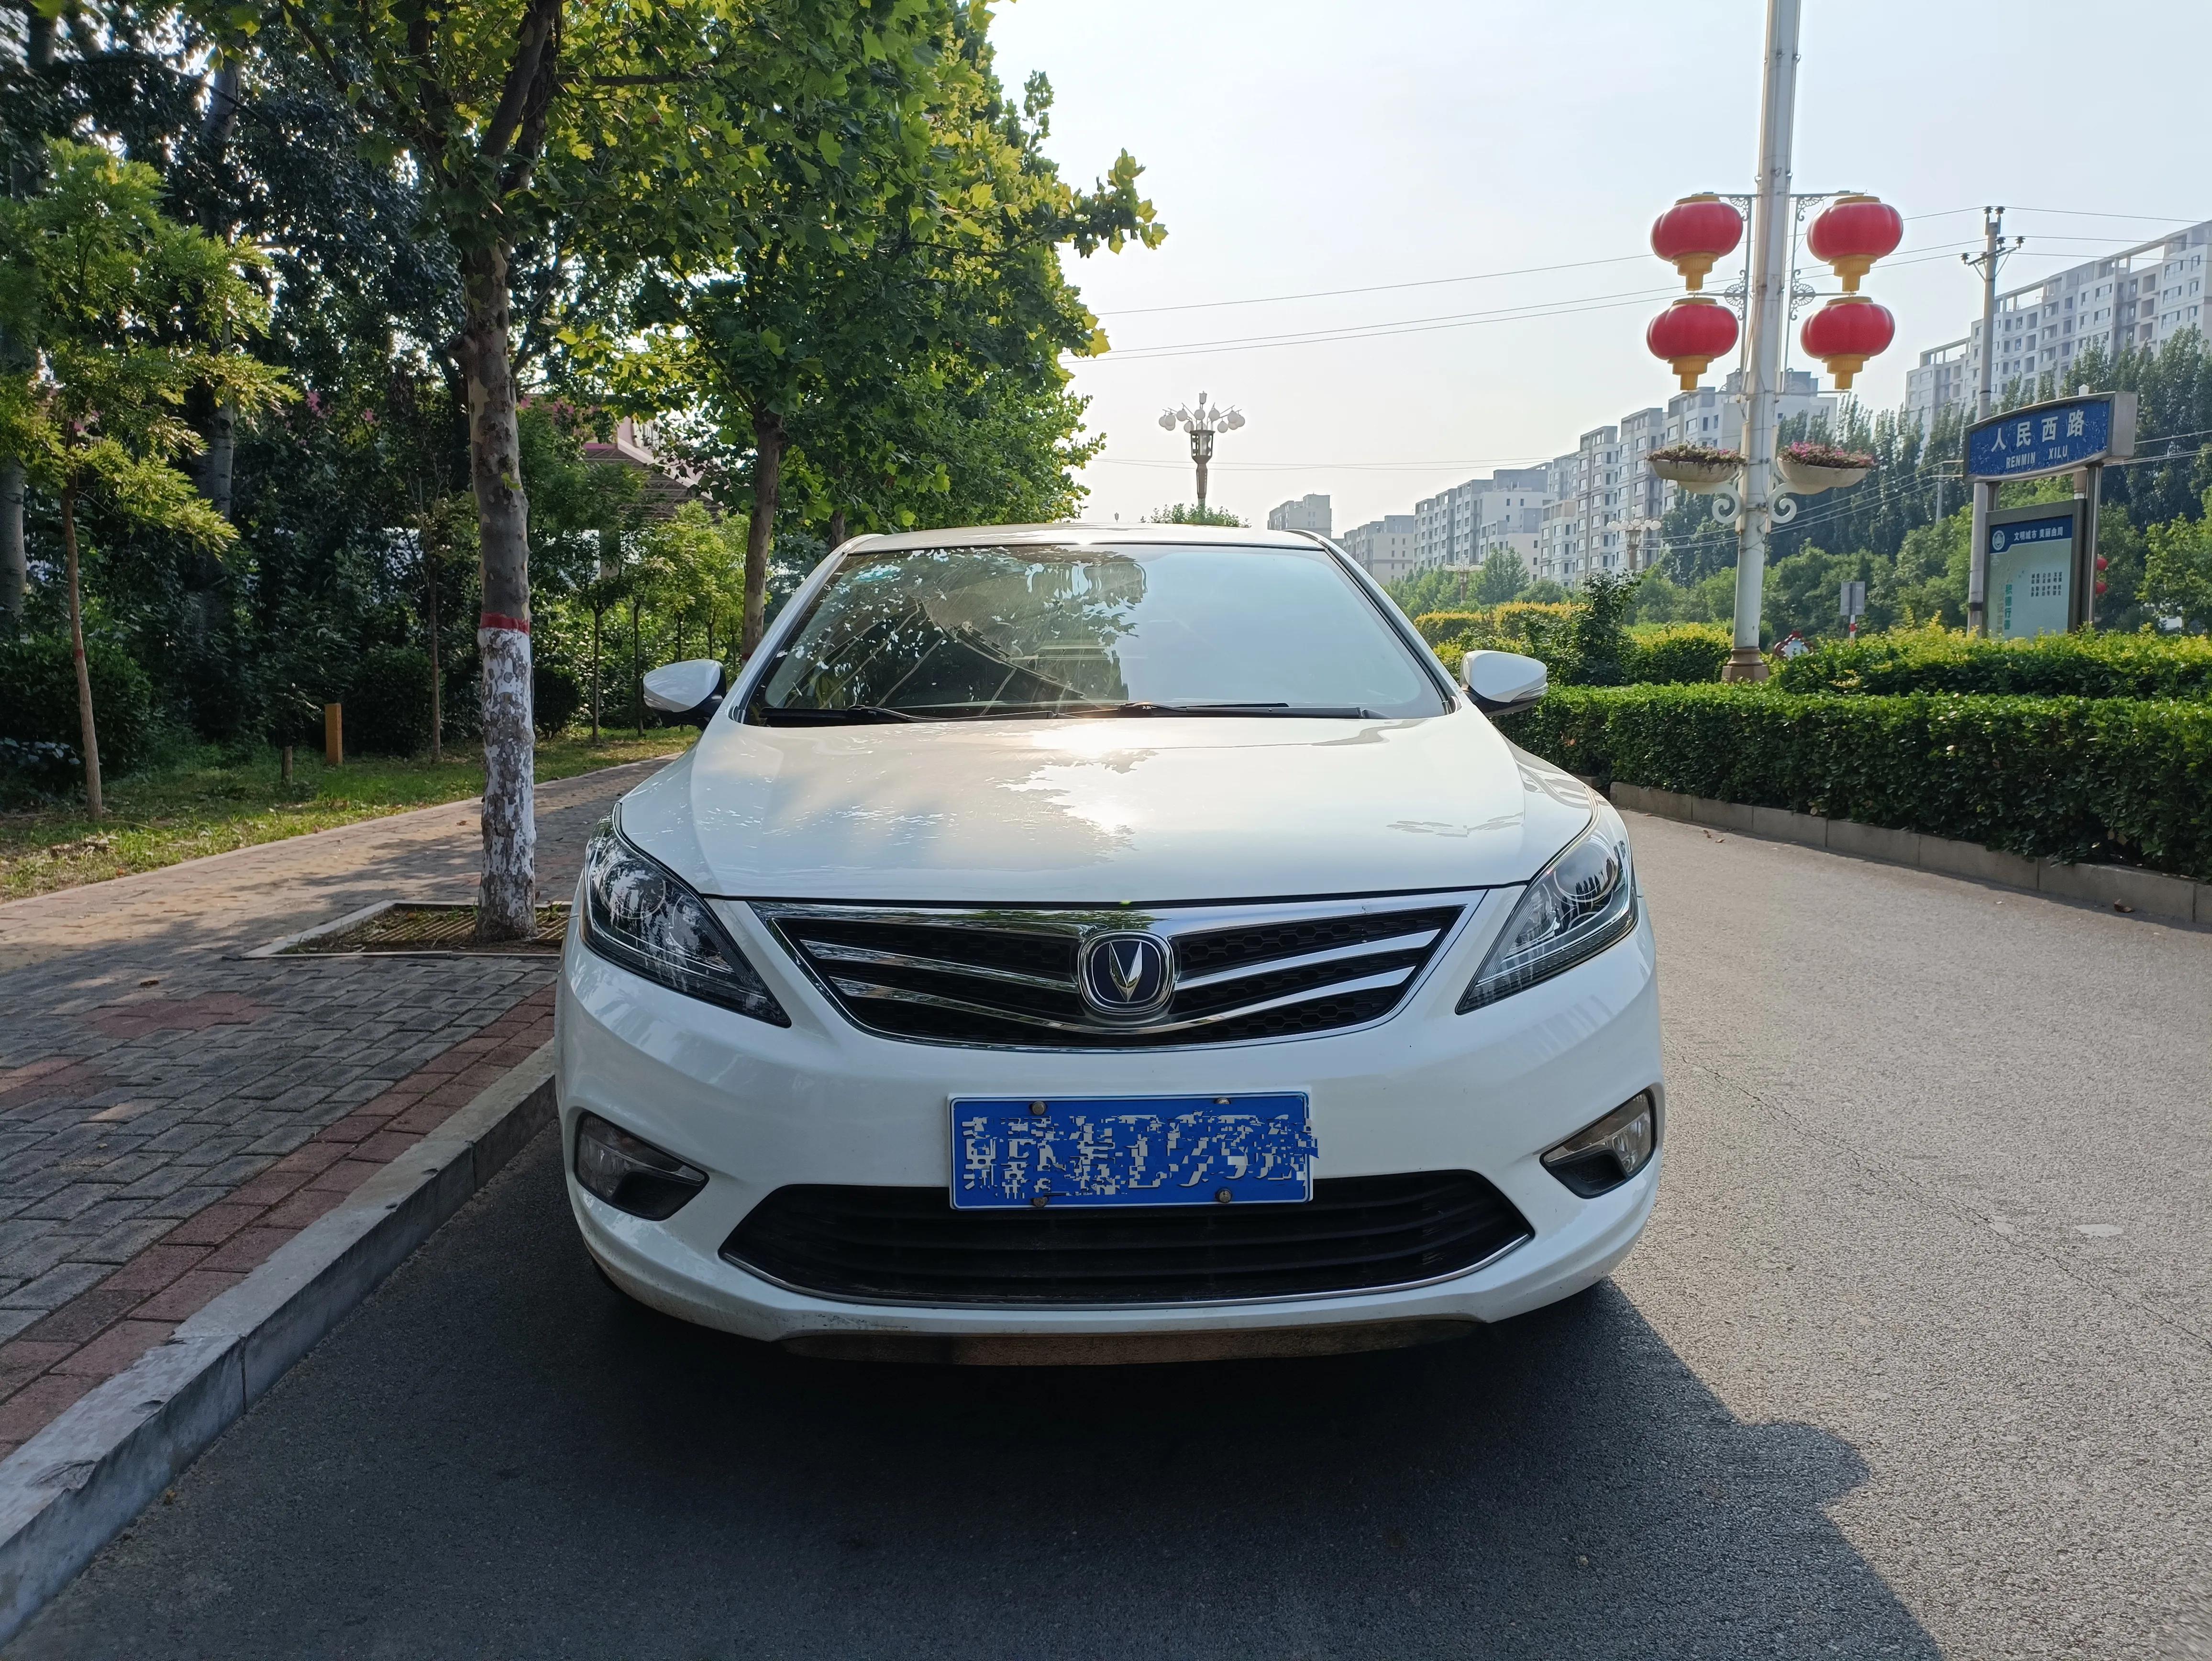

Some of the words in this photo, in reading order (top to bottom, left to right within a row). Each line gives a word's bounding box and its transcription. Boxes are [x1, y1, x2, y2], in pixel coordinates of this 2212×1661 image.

[1991, 410, 2084, 452] 人民西路
[2006, 452, 2036, 469] RENMIN
[2048, 444, 2068, 460] XILU
